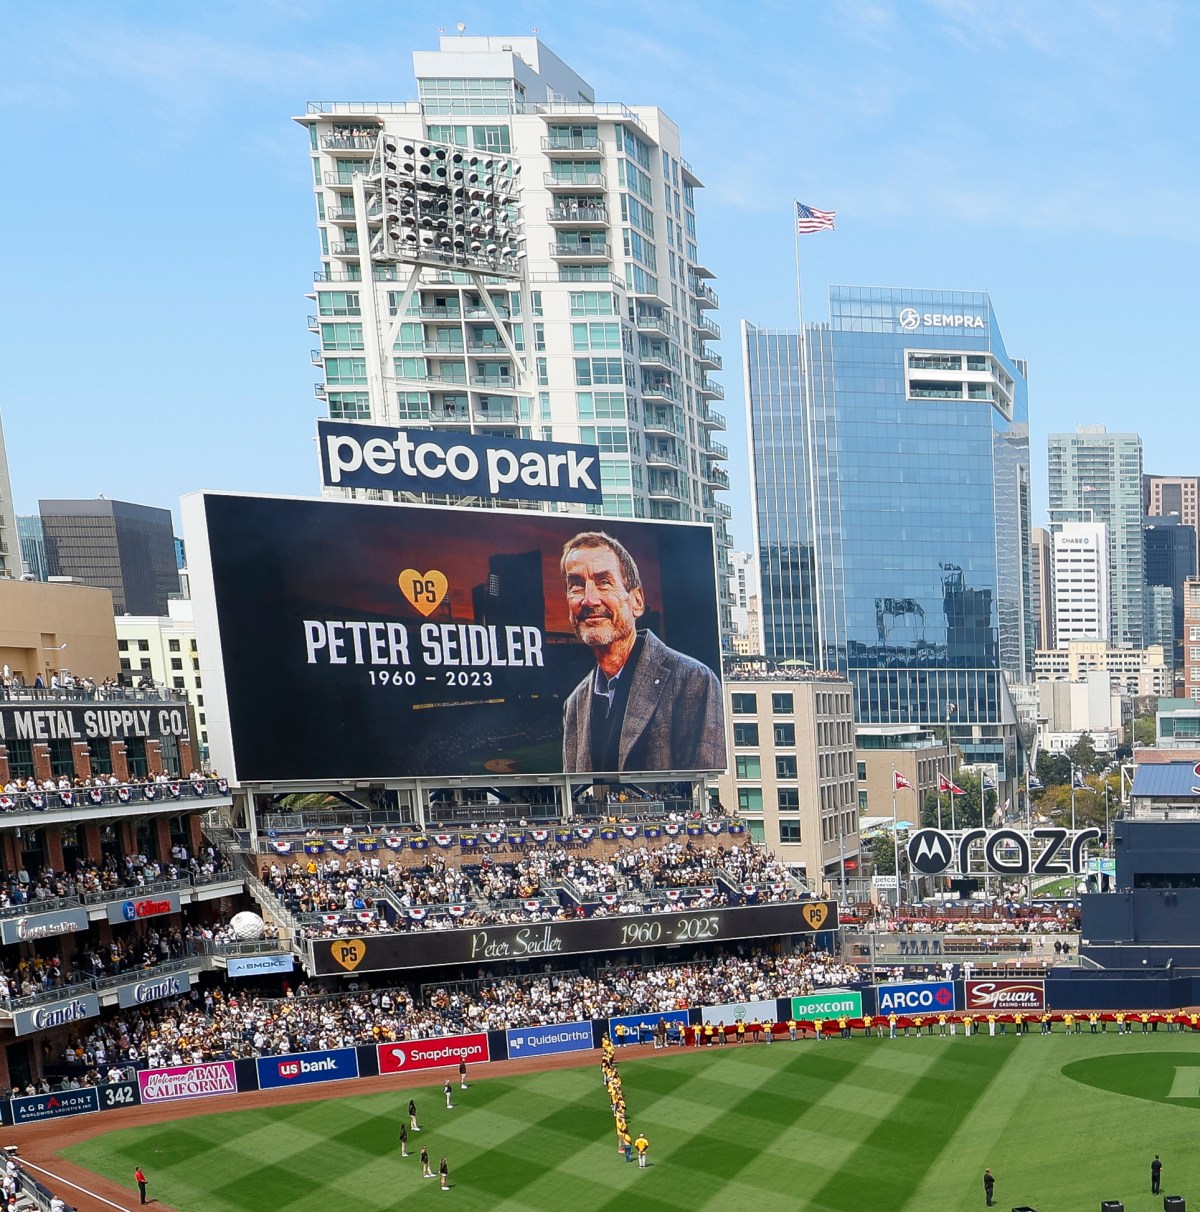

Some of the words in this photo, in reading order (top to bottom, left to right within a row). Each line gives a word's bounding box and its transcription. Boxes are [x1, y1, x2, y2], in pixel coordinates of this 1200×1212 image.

[923, 313, 985, 329] SEMPRA
[326, 431, 479, 483] petco
[487, 449, 598, 493] park
[413, 580, 436, 603] PS
[303, 620, 411, 665] PETER
[420, 623, 544, 667] SEIDLER
[368, 670, 416, 686] 1960
[446, 671, 493, 686] 2023
[14, 710, 81, 740] METAL
[84, 710, 150, 738] SUPPLY
[158, 709, 187, 736] CO.
[461, 846, 507, 856] ESTRELLA
[548, 842, 588, 851] LANDING
[959, 828, 1101, 874] razr
[809, 909, 822, 922] PS
[621, 921, 662, 945] 1960
[675, 917, 719, 941] 2023
[471, 931, 510, 959] Peter
[512, 925, 562, 955] Seidler
[341, 947, 358, 963] PS
[135, 977, 180, 1002] Canel's
[971, 983, 1037, 1006] Sycuan
[799, 1001, 854, 1015] dexcom
[880, 991, 933, 1009] ARCO
[33, 1000, 87, 1028] Canel's
[527, 1030, 589, 1047] QuidelOrtho
[411, 1045, 482, 1064] Snapdragon
[148, 1073, 187, 1086] Welcome
[187, 1071, 196, 1082] to
[195, 1064, 229, 1081] BAJA
[280, 1063, 298, 1075] us
[300, 1057, 335, 1072] bank
[106, 1087, 134, 1105] 342
[143, 1077, 234, 1099] CALIFORNIA
[21, 1109, 54, 1119] WORLDWIDE
[55, 1105, 82, 1114] LOGISTICS
